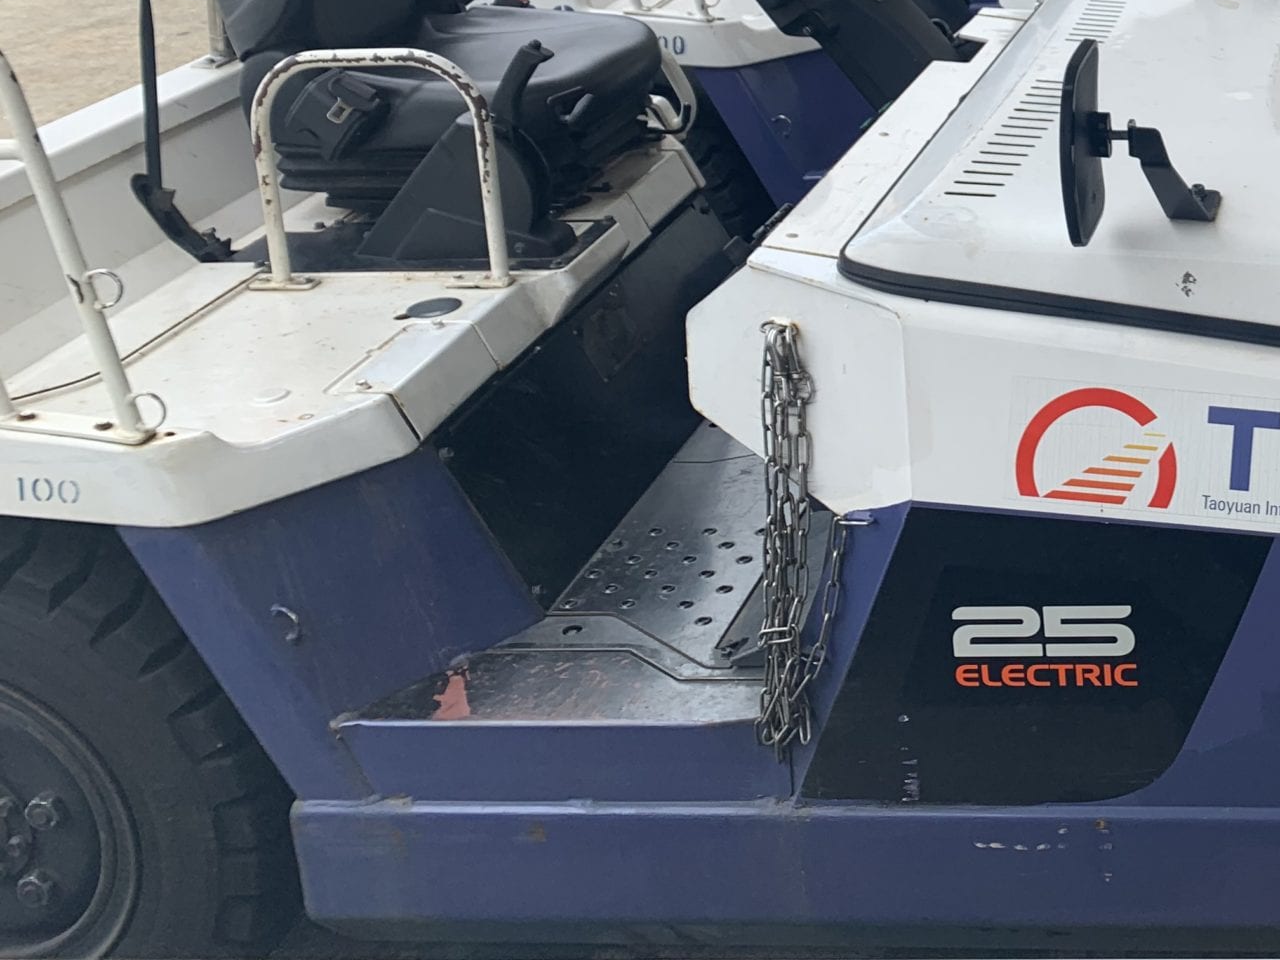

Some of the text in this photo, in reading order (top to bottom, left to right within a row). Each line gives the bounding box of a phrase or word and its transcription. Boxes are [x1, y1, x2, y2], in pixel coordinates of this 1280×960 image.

[17, 476, 81, 504] 100
[1202, 495, 1261, 516] Taoyuan
[952, 605, 1136, 658] 25
[955, 663, 1139, 687] ELECTRIC
